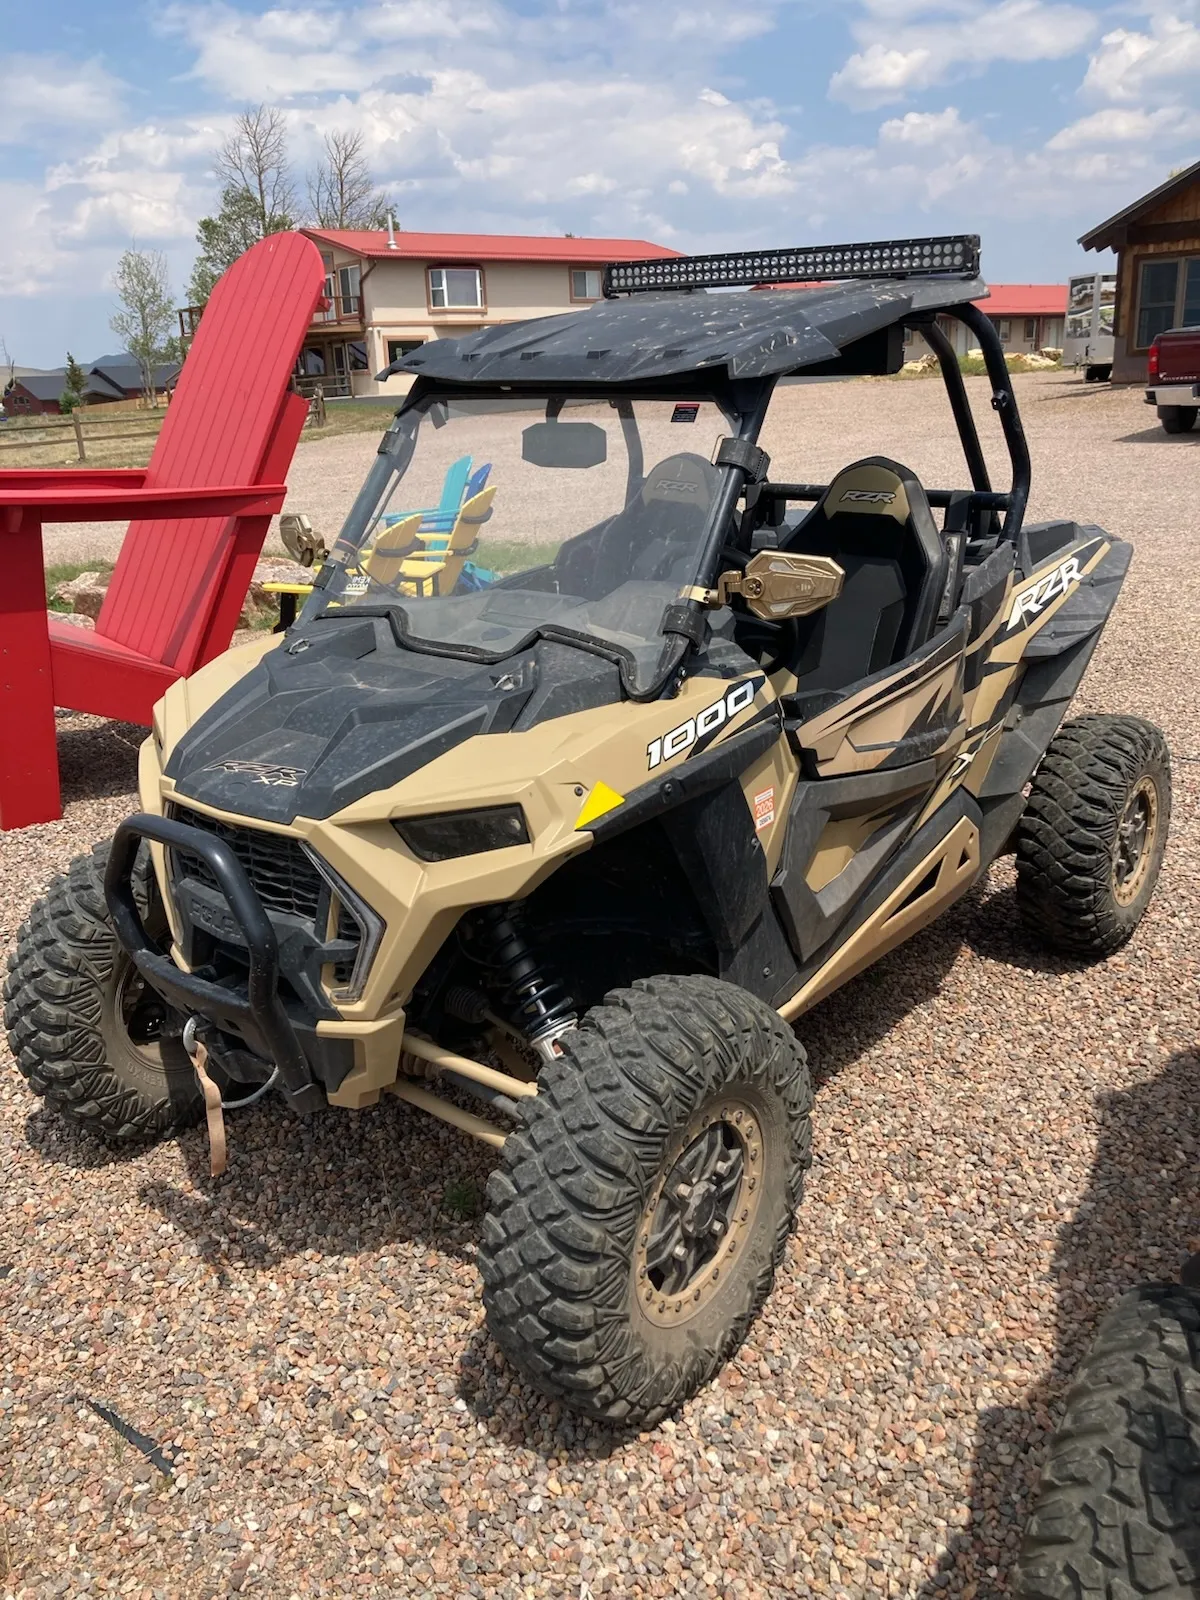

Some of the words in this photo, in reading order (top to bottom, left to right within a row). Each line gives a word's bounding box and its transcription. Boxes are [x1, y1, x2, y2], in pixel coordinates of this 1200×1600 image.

[656, 479, 699, 492] RZR
[839, 490, 896, 504] RZR
[1006, 557, 1084, 632] RZR
[646, 680, 755, 771] 1000
[203, 760, 307, 780] RZR
[251, 775, 299, 787] XP
